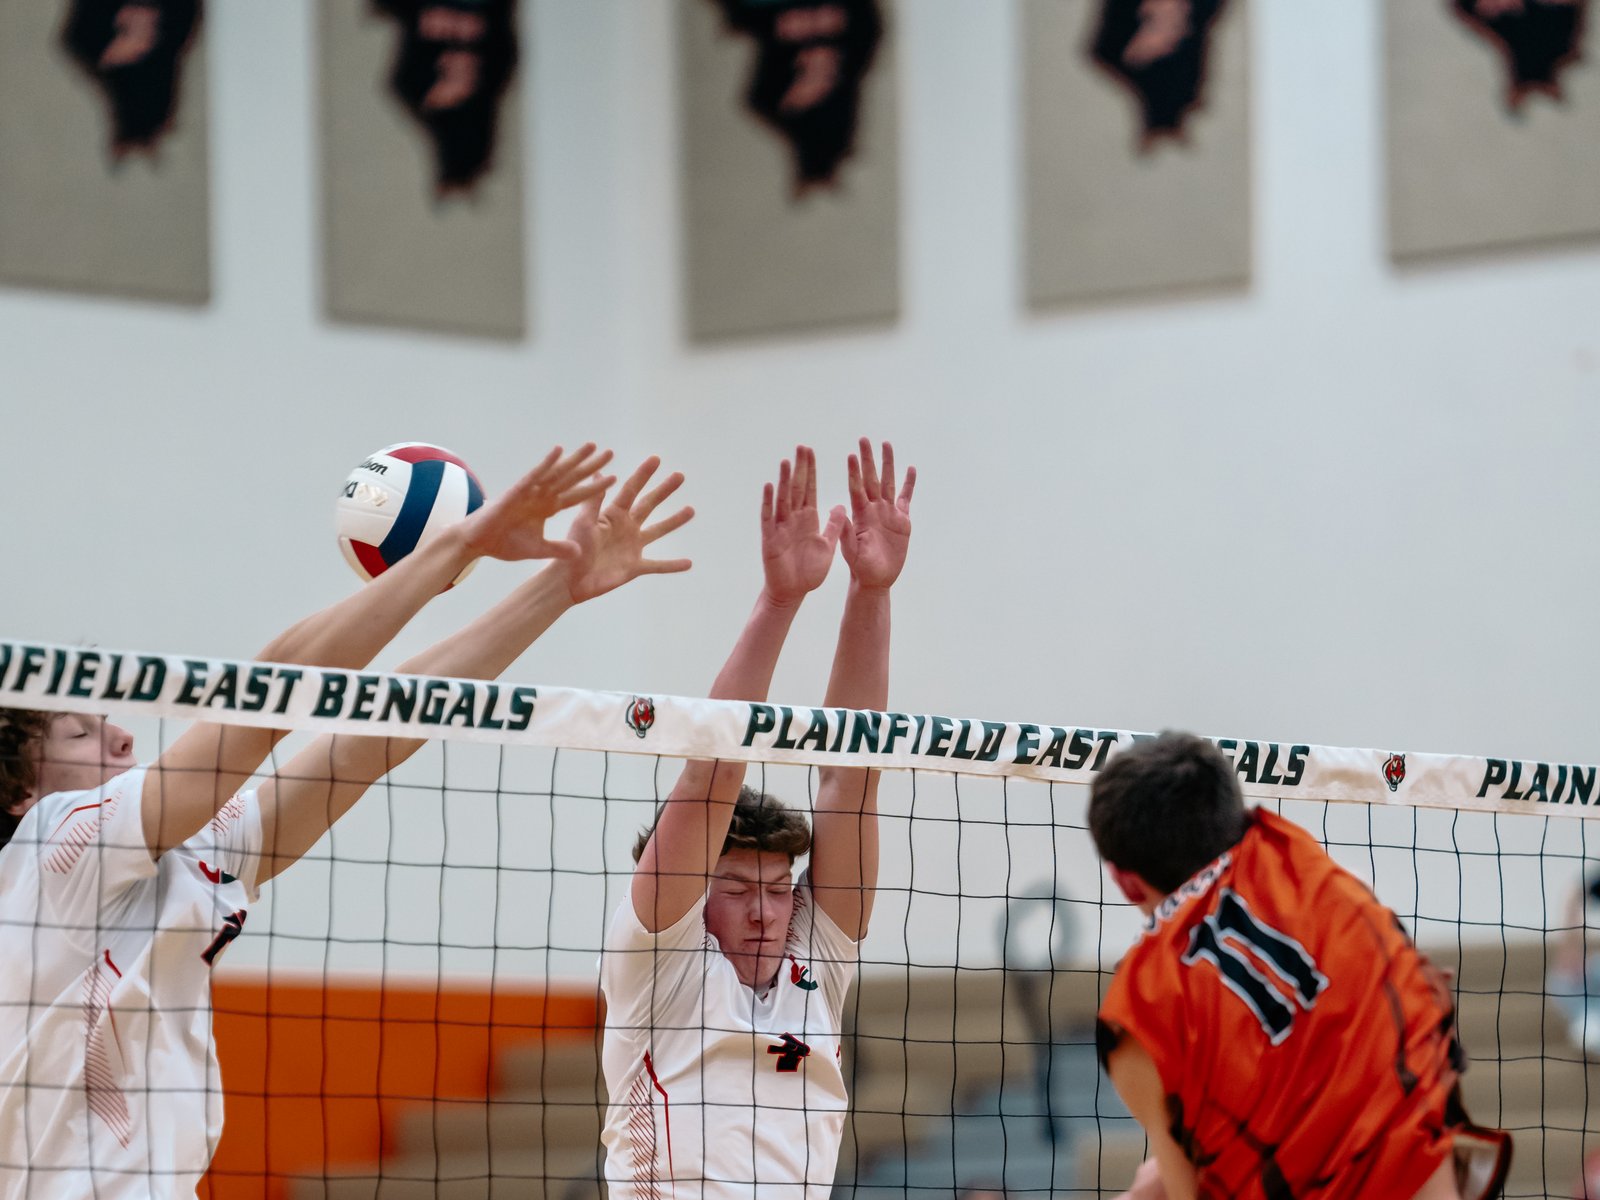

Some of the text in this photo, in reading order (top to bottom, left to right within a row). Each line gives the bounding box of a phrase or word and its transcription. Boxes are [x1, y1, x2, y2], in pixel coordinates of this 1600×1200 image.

[173, 660, 302, 714] EAST
[311, 672, 538, 731] BENGALS
[740, 703, 1007, 762] PLAINFIELD
[1012, 724, 1119, 772] EAST
[1476, 758, 1600, 806] PLAIN
[1180, 886, 1330, 1047] 11
